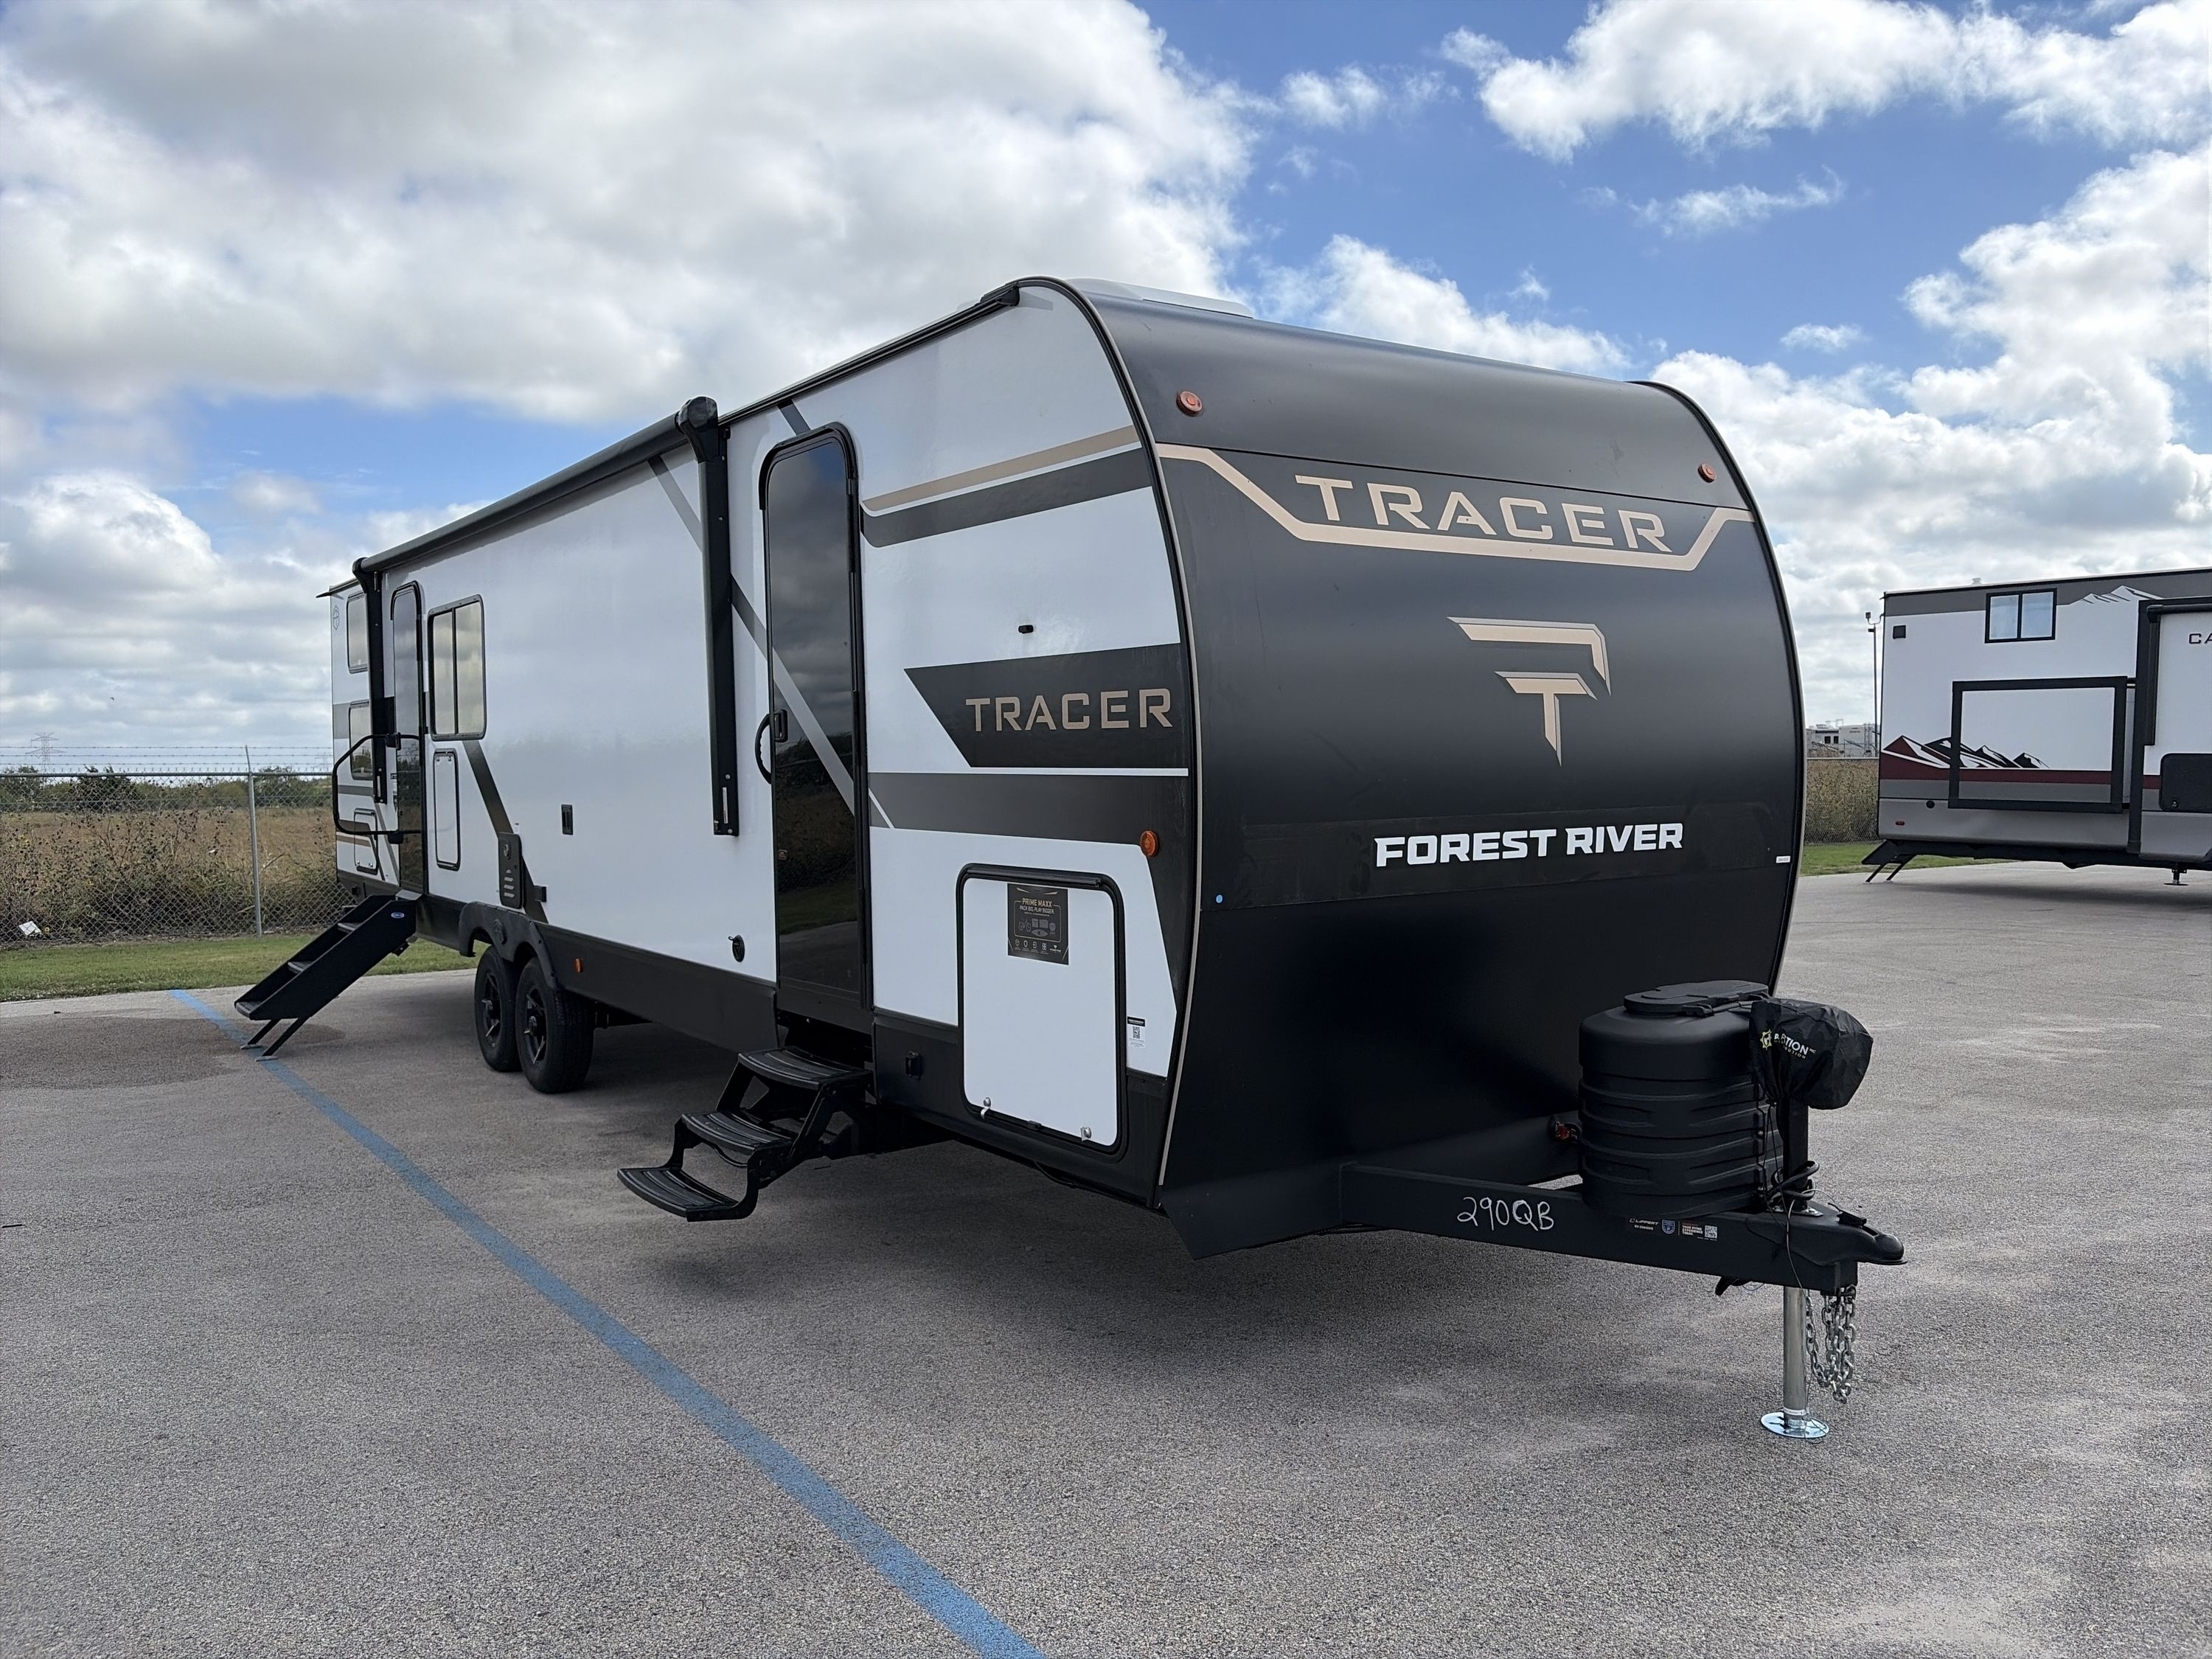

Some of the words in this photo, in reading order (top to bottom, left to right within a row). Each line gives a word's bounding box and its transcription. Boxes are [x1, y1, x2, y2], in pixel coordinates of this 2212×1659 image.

[1295, 475, 1672, 552] TRACER
[965, 688, 1173, 731] TRACER
[1374, 829, 1557, 867] FOREST
[1565, 823, 1684, 855] RIVER
[1022, 898, 1037, 906] PRIME
[1037, 900, 1052, 908] MAXX
[1457, 1196, 1554, 1231] 290QB
